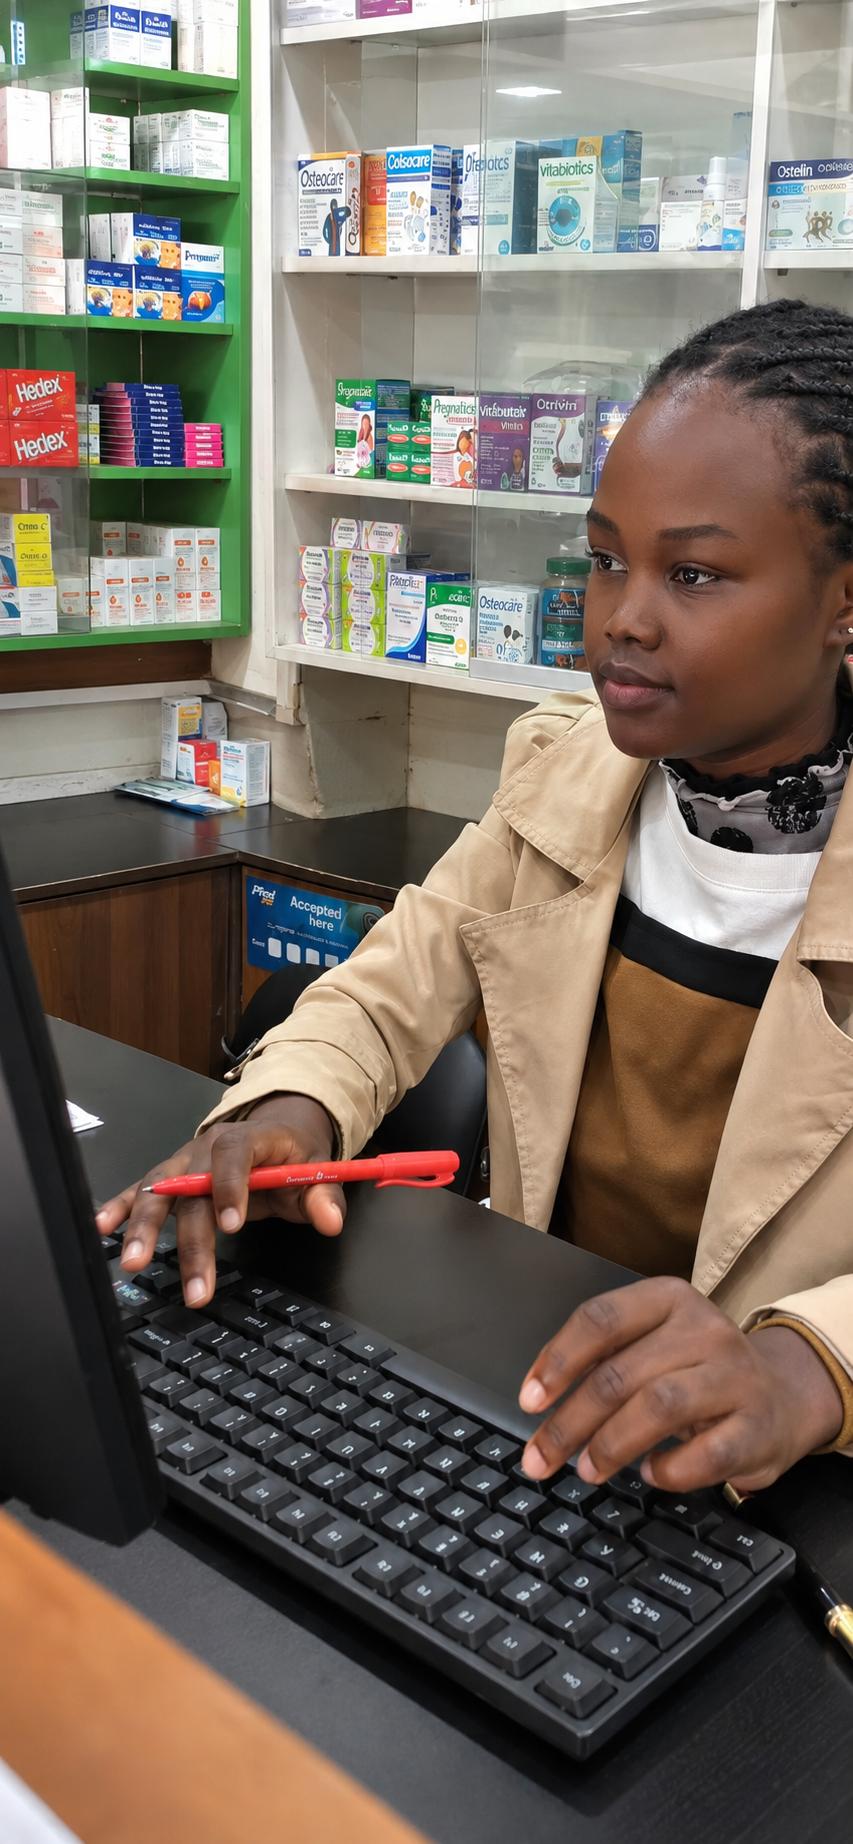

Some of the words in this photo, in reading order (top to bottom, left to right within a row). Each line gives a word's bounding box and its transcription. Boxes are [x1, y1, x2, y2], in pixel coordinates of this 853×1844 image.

[540, 160, 594, 177] vitabiotics
[778, 164, 812, 178] Ostelin
[300, 169, 344, 188] Osteocare
[15, 376, 63, 403] Hedex
[13, 430, 68, 461] Hedex
[479, 595, 524, 613] Osteocare
[290, 895, 342, 920] Accepted
[309, 914, 334, 932] here
